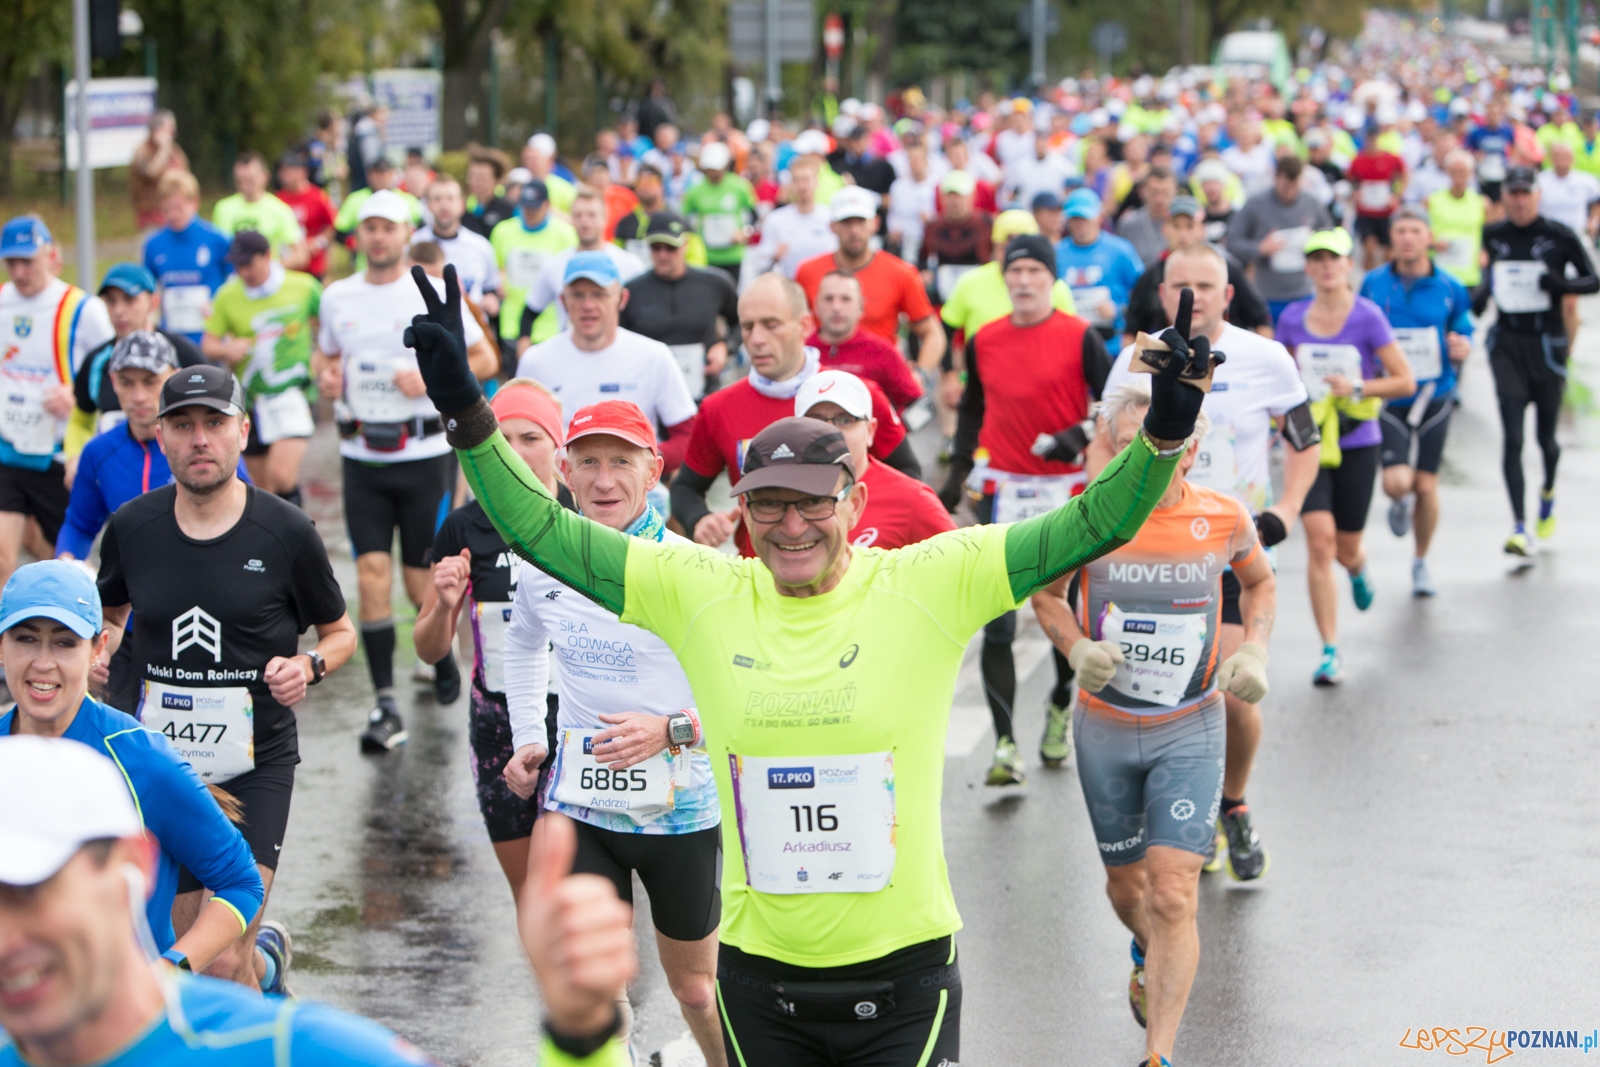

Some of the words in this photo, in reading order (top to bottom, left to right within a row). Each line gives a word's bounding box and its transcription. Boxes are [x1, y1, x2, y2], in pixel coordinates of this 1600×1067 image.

[1108, 563, 1172, 584] MOVE
[1174, 562, 1207, 583] ON
[544, 590, 562, 601] 4F
[559, 619, 589, 635] SIŁA
[567, 635, 634, 654] ODWAGA
[560, 647, 637, 668] SZYBKOŚĆ
[1119, 641, 1186, 666] 2946
[147, 663, 173, 678] Polski
[176, 668, 203, 681] Dom
[207, 668, 258, 682] Rolniczy
[618, 674, 639, 683] 2016
[164, 695, 191, 708] 17.PKO
[744, 681, 858, 718] POZNAŃ
[743, 718, 757, 727] IT'S
[758, 719, 764, 728] A
[765, 720, 779, 728] BIG
[807, 718, 820, 727] GO
[822, 716, 840, 726] RUN
[162, 721, 228, 744] 4477
[580, 767, 648, 792] 6865
[771, 772, 812, 784] 17.PKO
[590, 796, 631, 809] Andrzej
[789, 804, 839, 833] 116
[782, 840, 853, 853] Arkadiusz
[1125, 835, 1142, 849] ON
[827, 871, 845, 881] 4F
